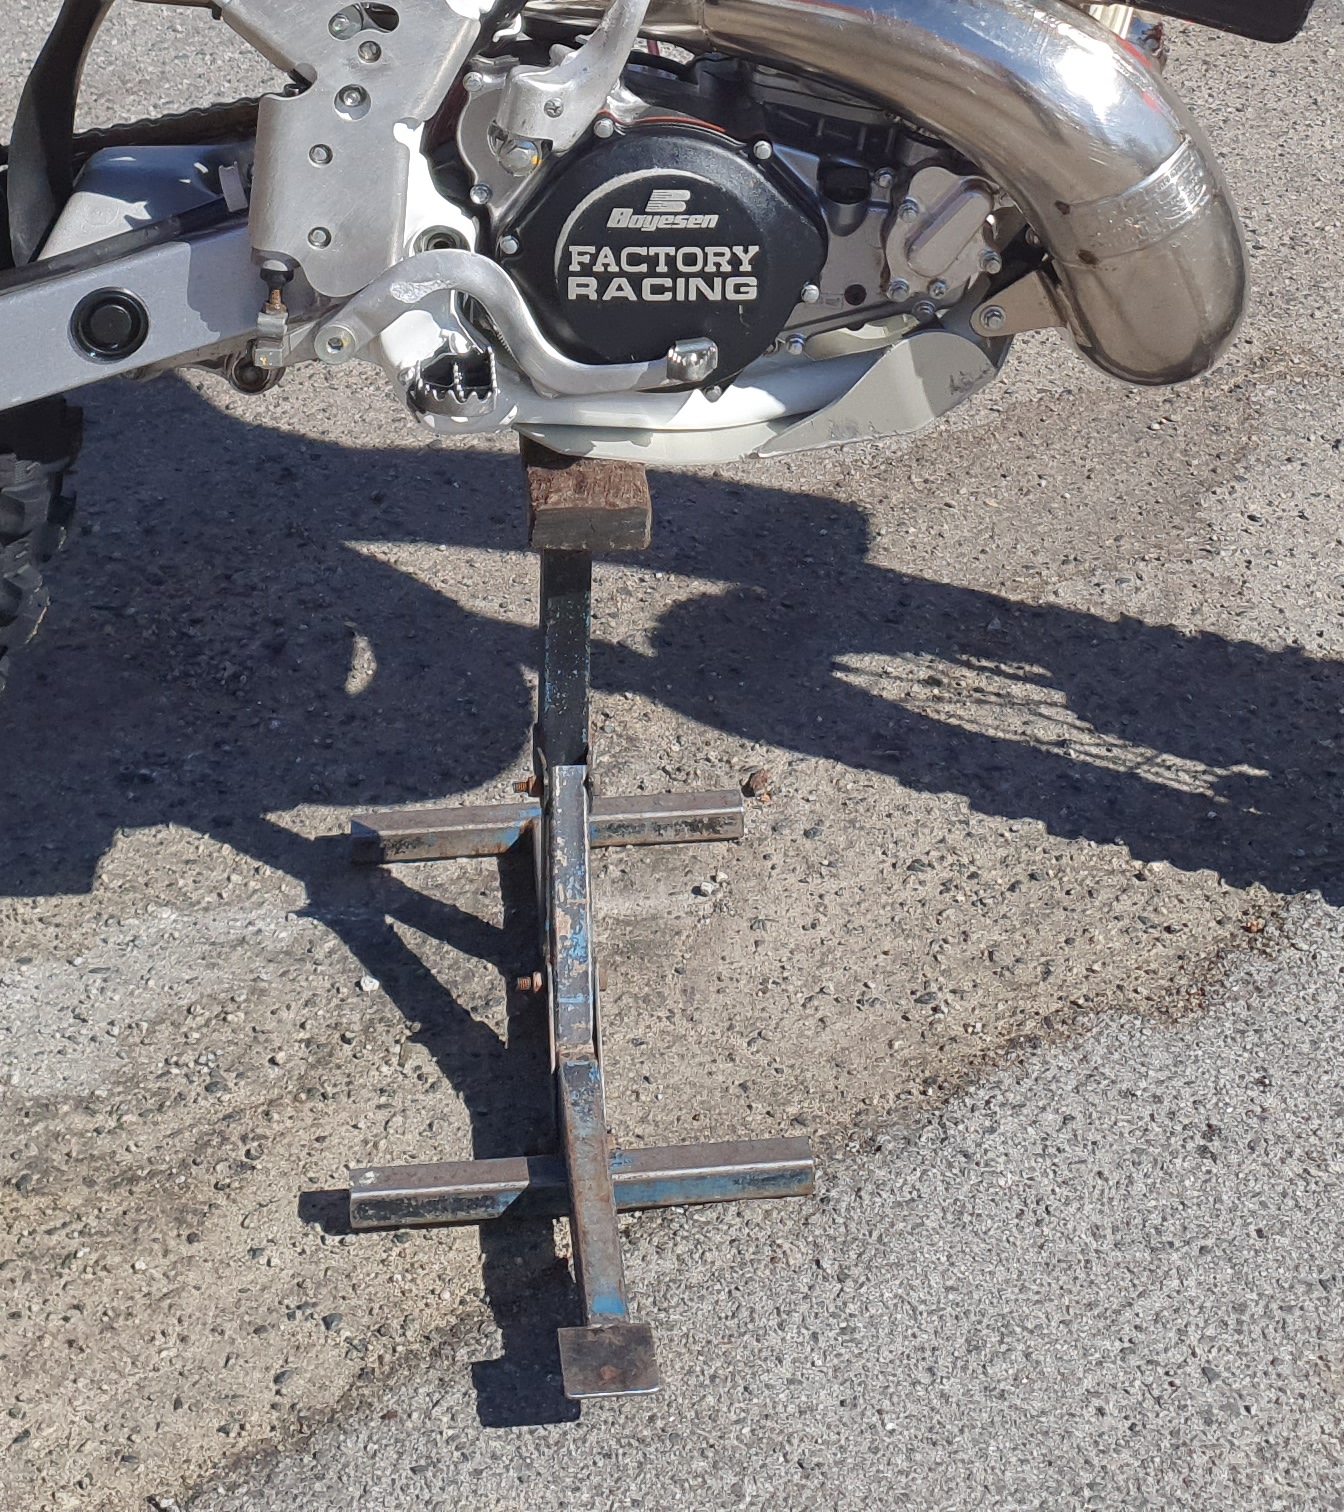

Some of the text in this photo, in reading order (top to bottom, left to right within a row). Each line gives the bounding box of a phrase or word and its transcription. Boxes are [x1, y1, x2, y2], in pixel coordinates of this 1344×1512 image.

[607, 207, 719, 232] Boyesen
[568, 245, 760, 273] FACTORY
[567, 276, 758, 301] RACING
